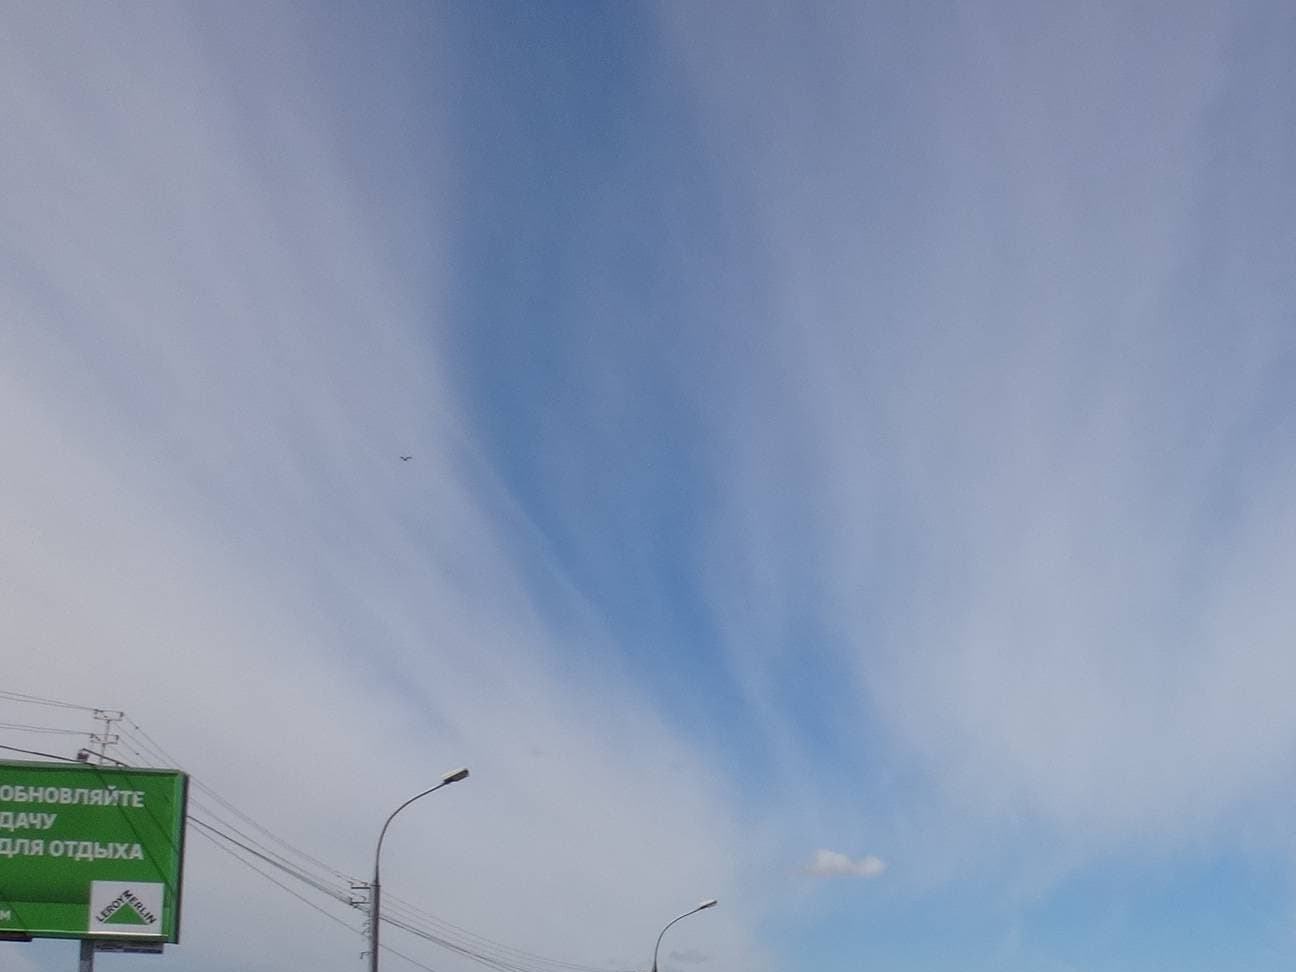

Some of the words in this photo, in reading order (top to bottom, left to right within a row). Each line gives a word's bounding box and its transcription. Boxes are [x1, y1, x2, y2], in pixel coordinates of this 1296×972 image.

[0, 785, 145, 808] ОБНОВЛЯЙТЕ
[0, 811, 57, 831] ДАЧУ
[49, 839, 144, 861] ОТДЫХА
[96, 893, 126, 924] LEROY
[122, 889, 157, 925] MERLIN
